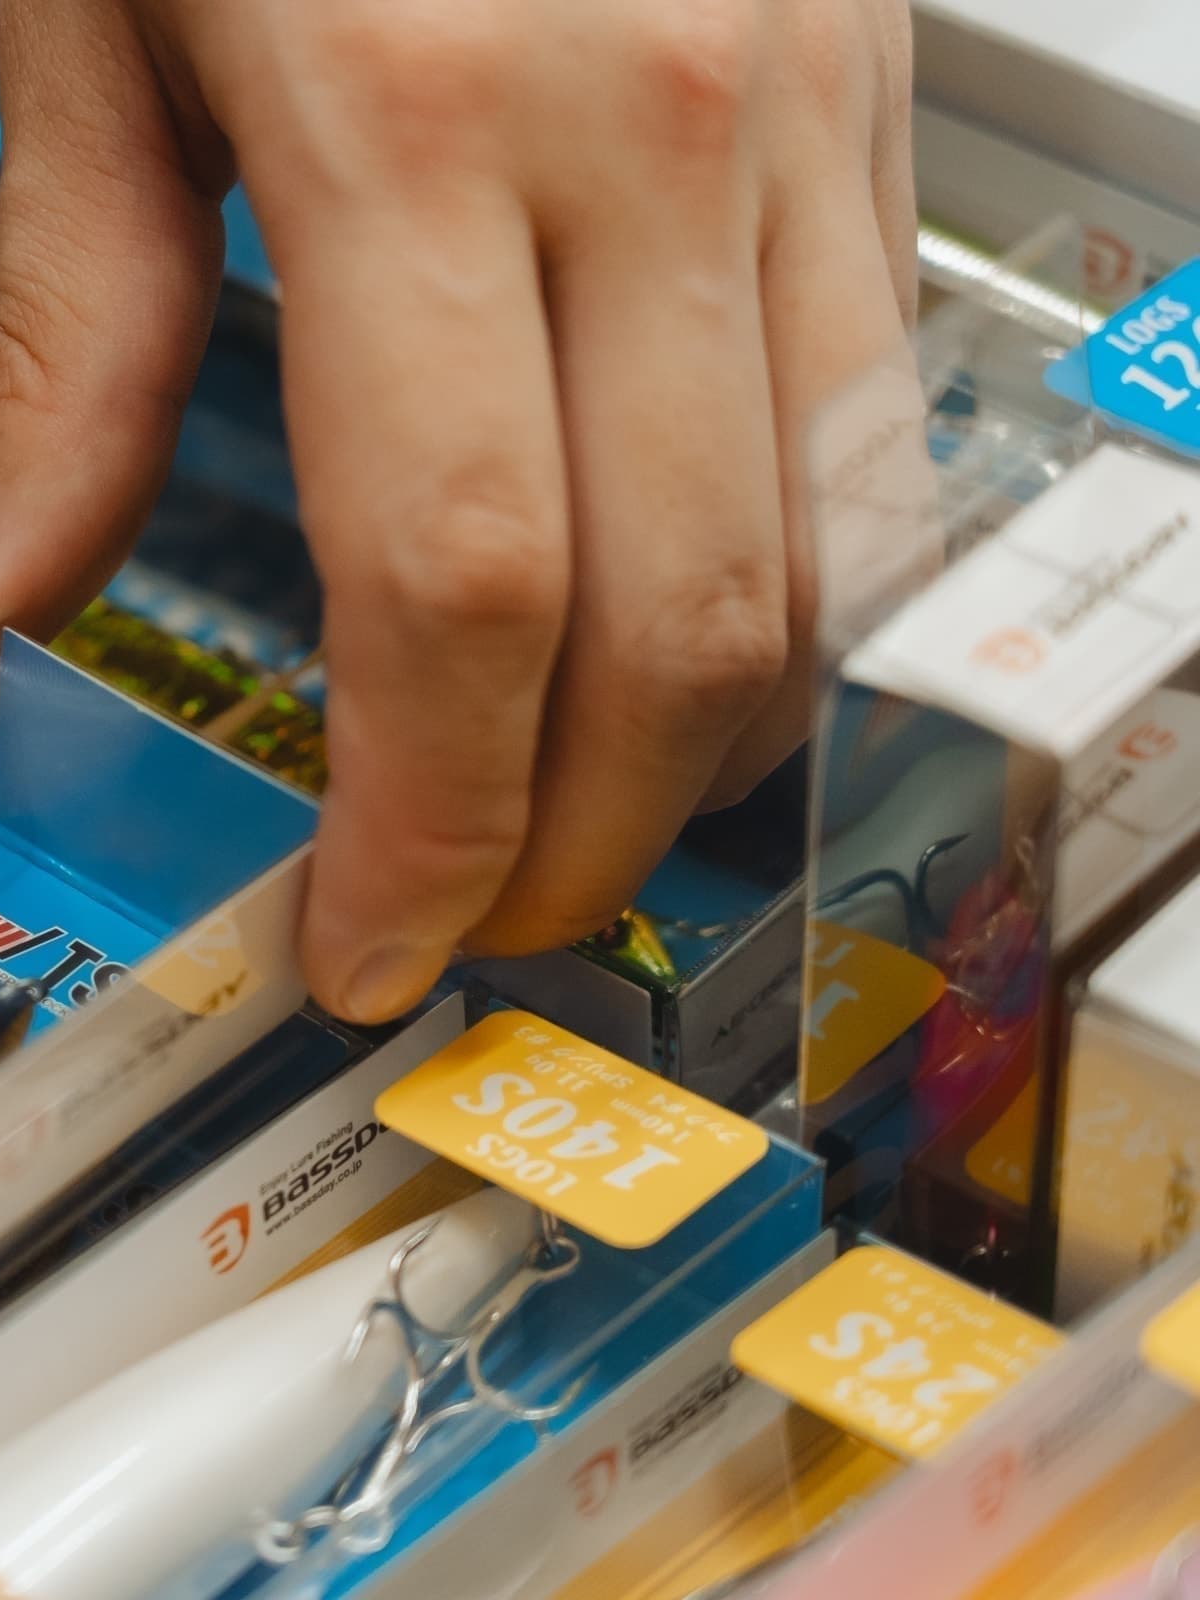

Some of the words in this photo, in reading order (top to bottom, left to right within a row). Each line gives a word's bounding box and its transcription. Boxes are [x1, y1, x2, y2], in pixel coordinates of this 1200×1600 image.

[1105, 295, 1190, 355] LOGS
[1121, 313, 1200, 411] 12
[259, 1170, 289, 1196] Enjoy
[290, 1151, 314, 1172] Lure
[315, 1121, 353, 1153] Fishing
[452, 1073, 680, 1190] 140S
[465, 1132, 578, 1197] LOGS
[266, 1159, 363, 1236] www.bassday.co.jp
